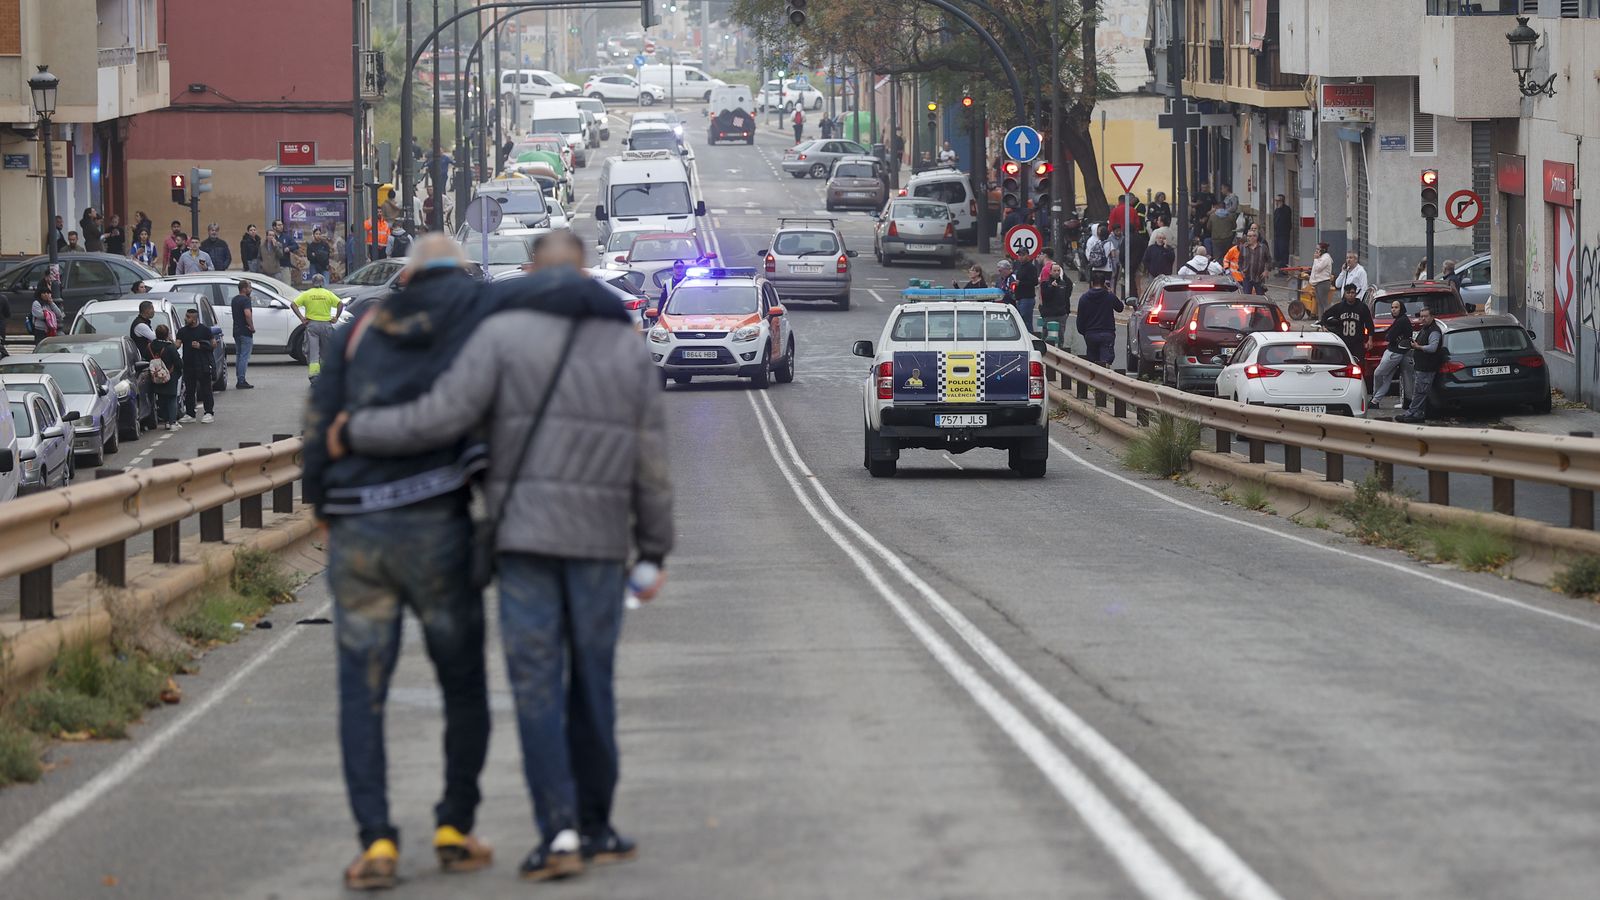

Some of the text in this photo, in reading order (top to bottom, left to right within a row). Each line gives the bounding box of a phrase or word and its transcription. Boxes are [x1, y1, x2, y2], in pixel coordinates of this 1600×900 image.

[1013, 237, 1034, 249] 40
[990, 313, 1010, 321] PLV
[1343, 320, 1356, 337] 08
[1495, 366, 1508, 374] JKT
[941, 415, 985, 425] 7571 JLS
